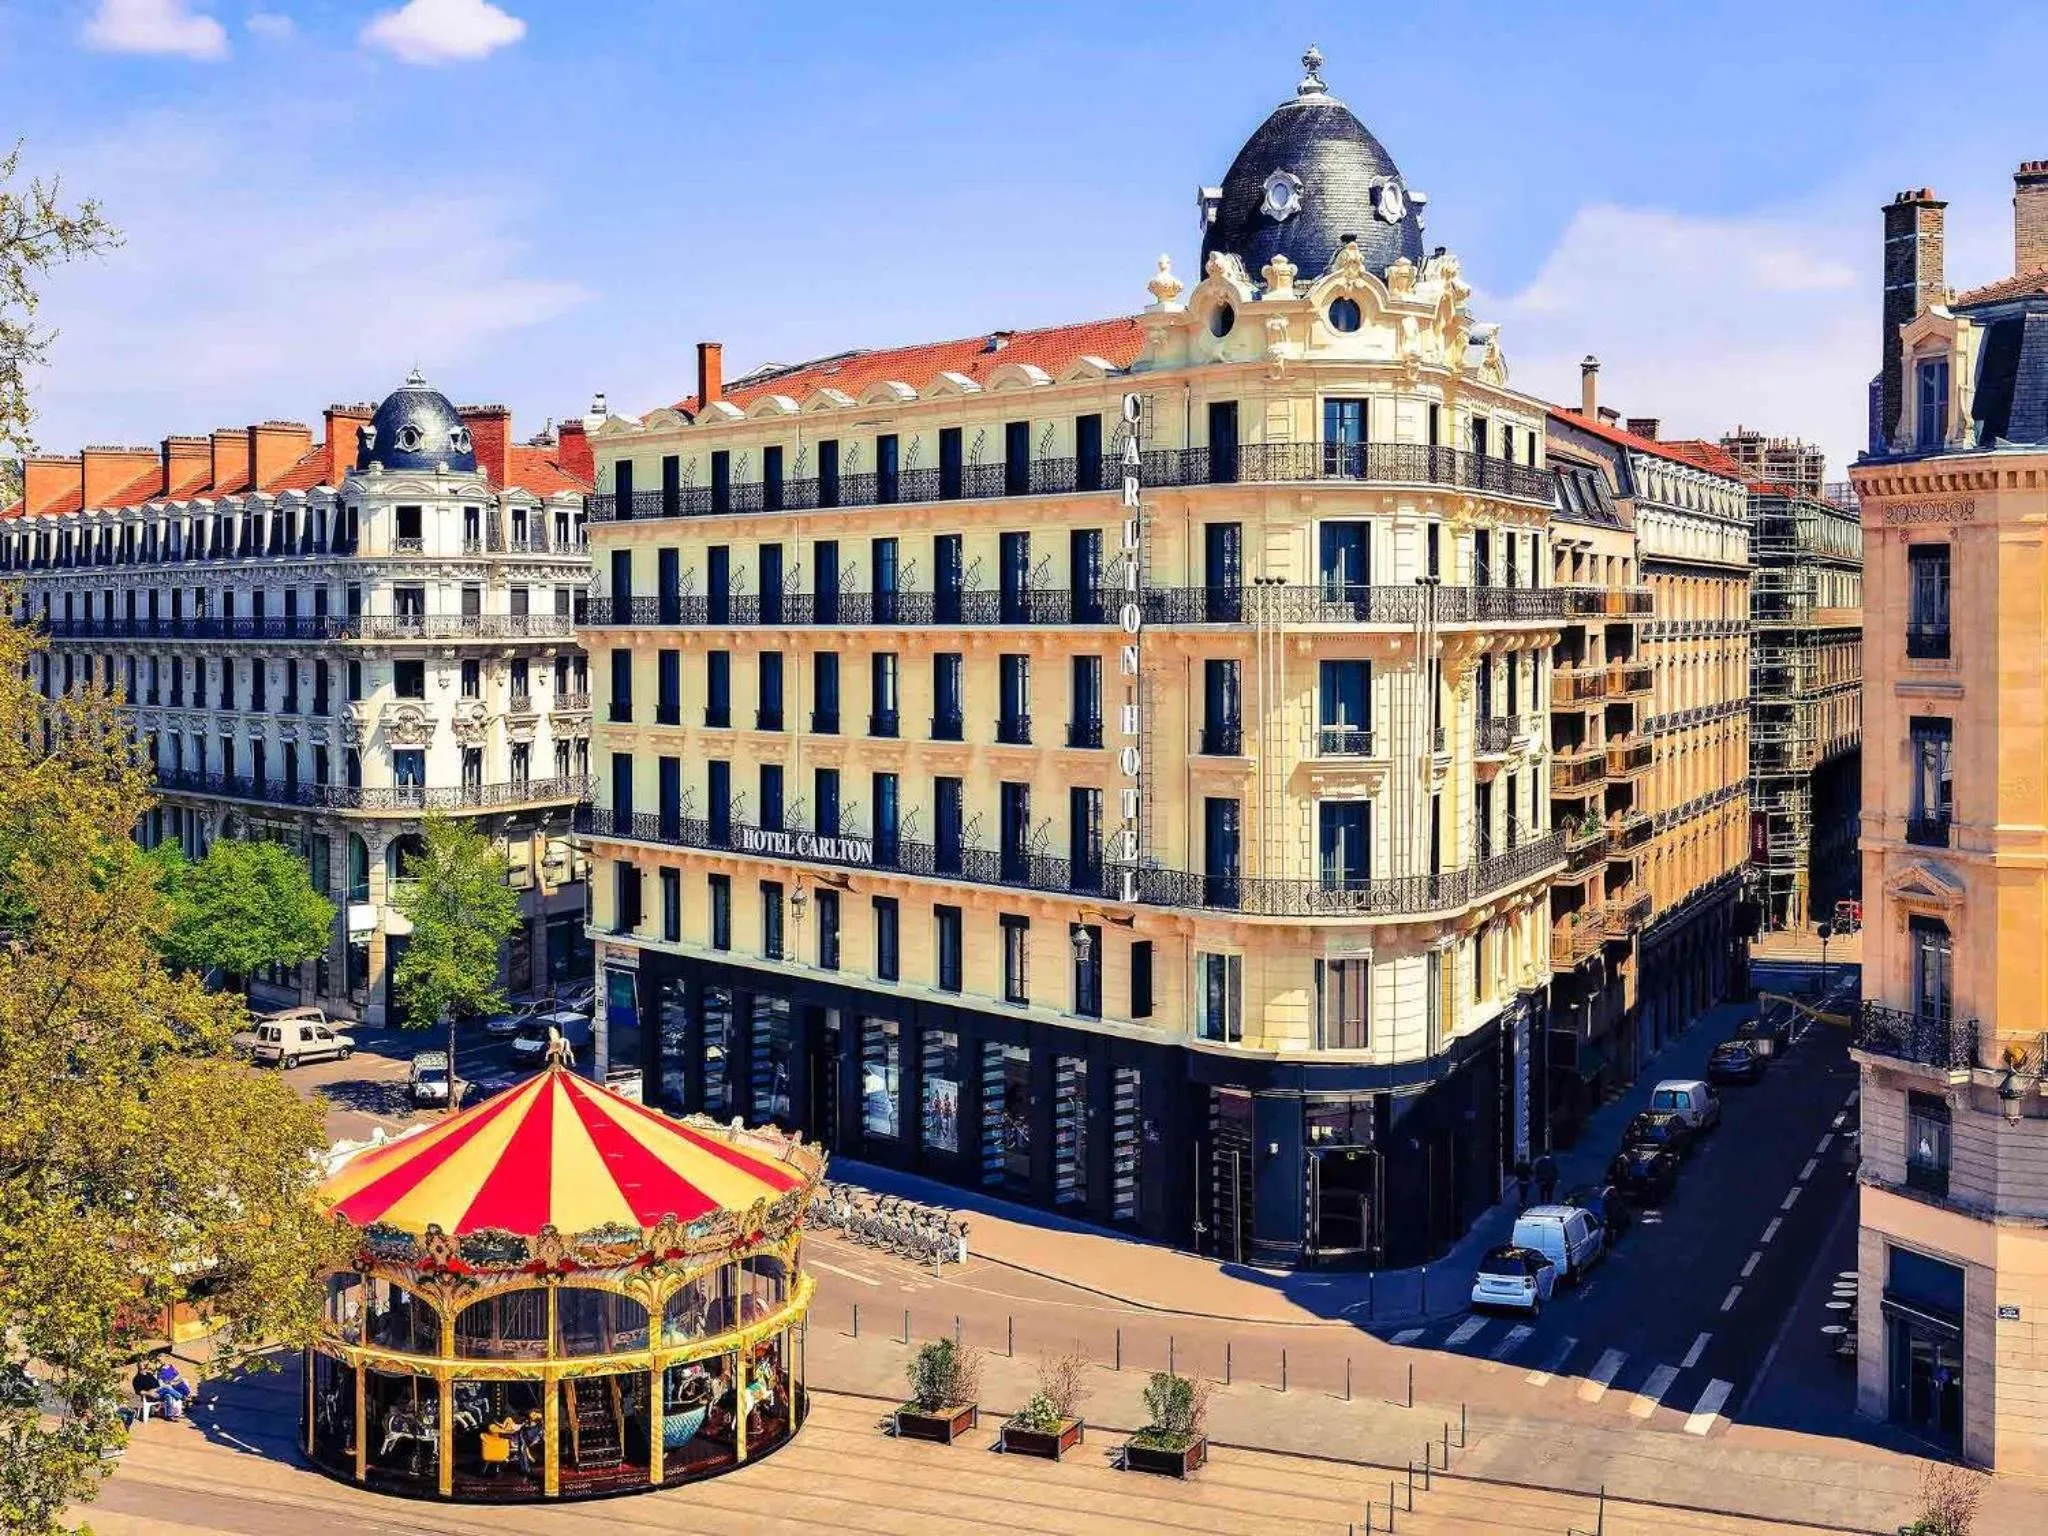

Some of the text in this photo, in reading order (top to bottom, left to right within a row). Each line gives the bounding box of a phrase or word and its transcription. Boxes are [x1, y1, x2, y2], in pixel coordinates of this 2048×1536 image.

[1119, 392, 1141, 902] CARLTON HOTEL
[743, 829, 873, 864] HOTEL CARLTON
